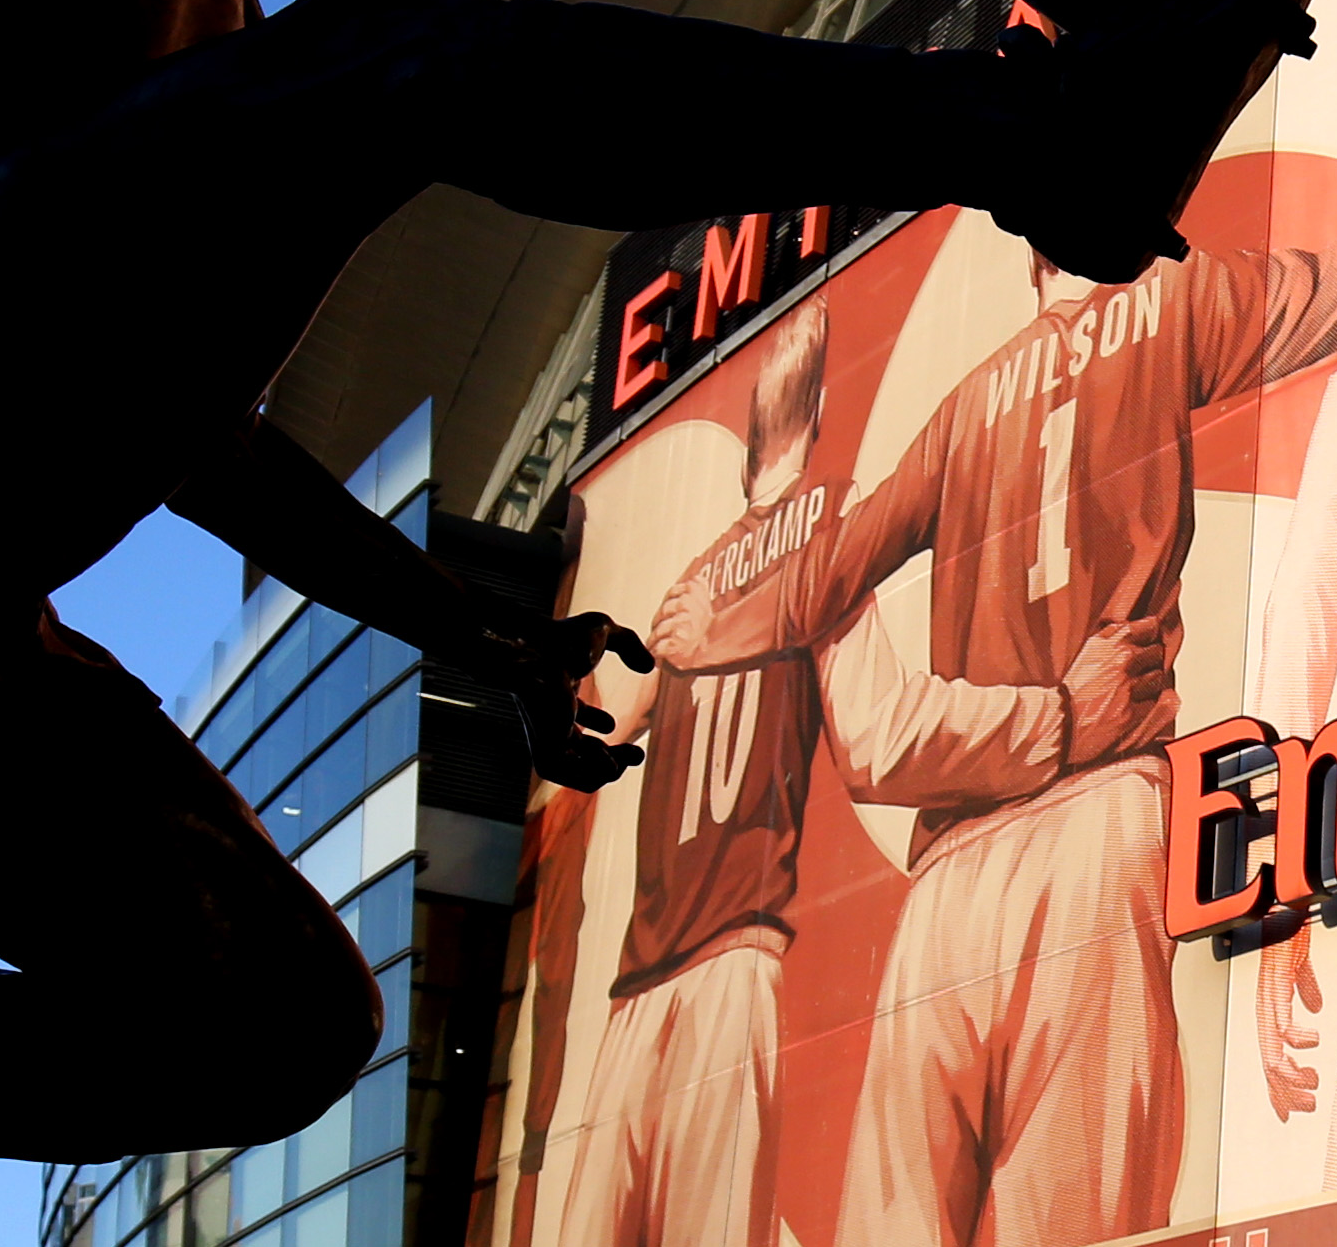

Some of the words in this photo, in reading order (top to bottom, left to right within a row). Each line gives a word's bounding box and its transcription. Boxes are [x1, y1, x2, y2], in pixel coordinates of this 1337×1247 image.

[986, 275, 1161, 429] WILSON
[1027, 398, 1077, 603] 1
[678, 668, 761, 845] 10
